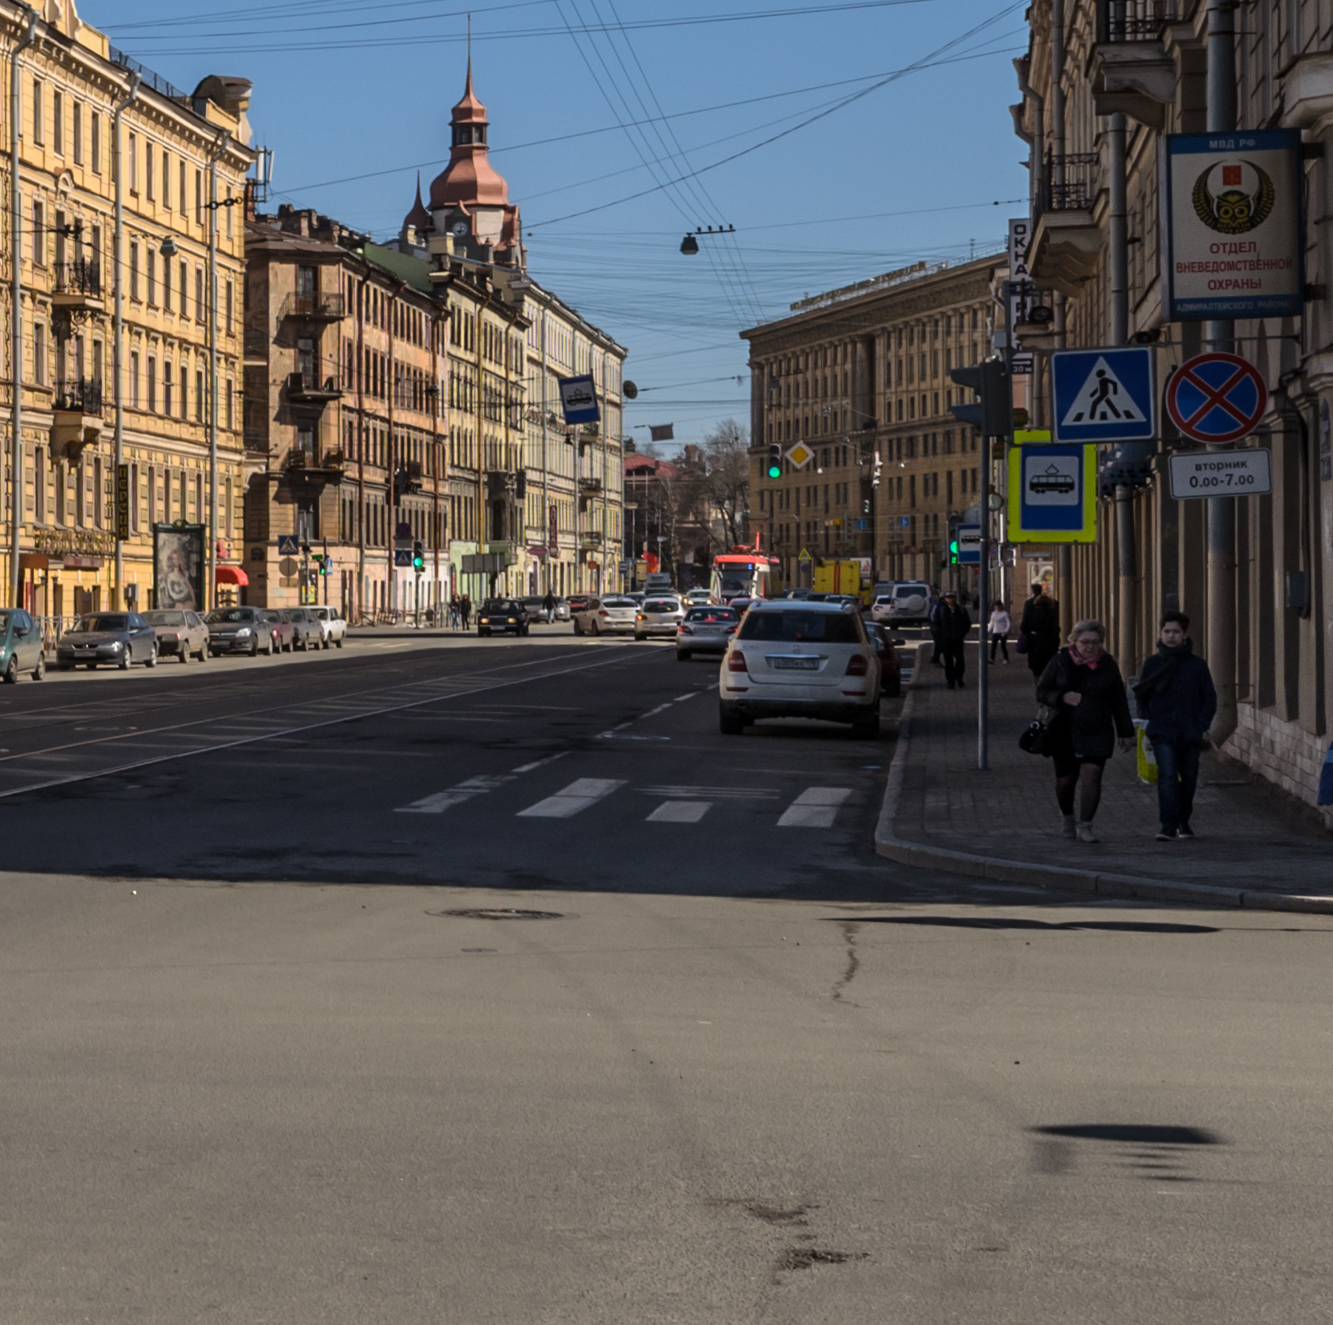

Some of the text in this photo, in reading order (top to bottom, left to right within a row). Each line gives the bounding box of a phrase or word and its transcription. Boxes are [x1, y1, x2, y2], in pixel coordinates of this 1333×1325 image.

[1209, 138, 1256, 149] МВД РФ
[1014, 224, 1028, 275] ОКНА
[1209, 242, 1257, 255] ОТДЕЛ
[1207, 278, 1262, 291] ОХРАНЫ
[1195, 461, 1248, 472] вторник
[1189, 474, 1254, 488] 0.00-7.00
